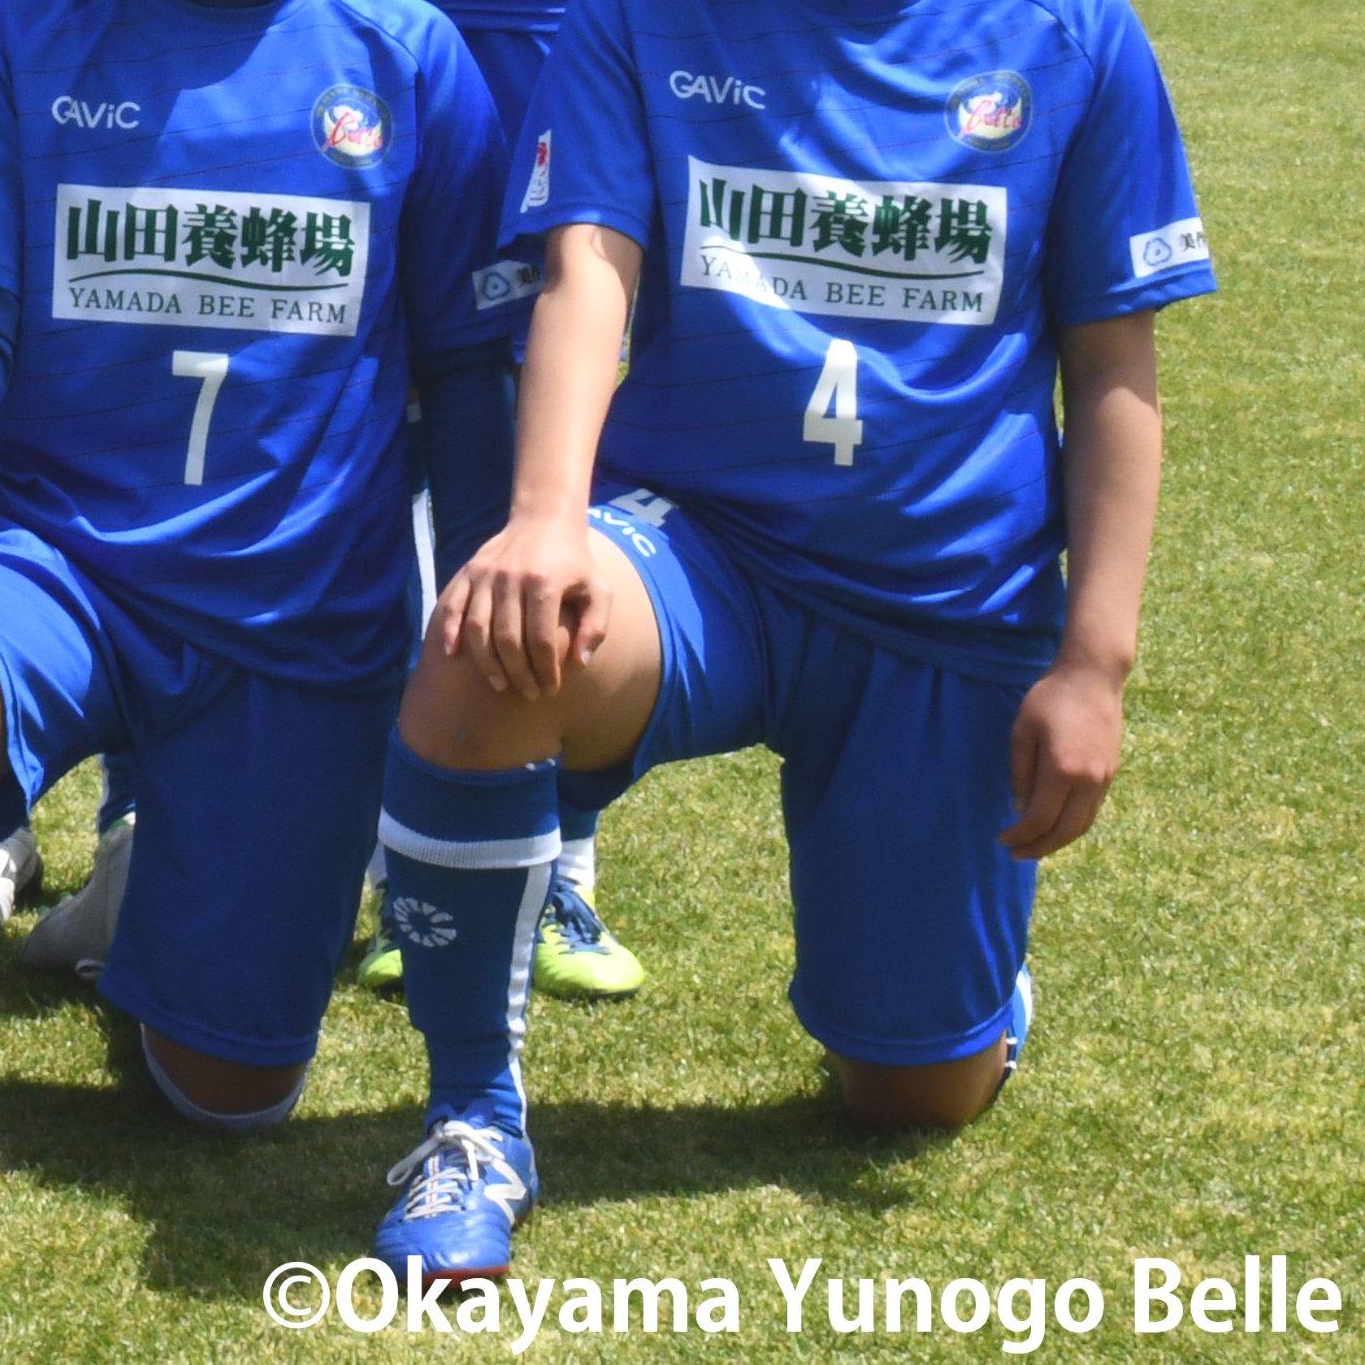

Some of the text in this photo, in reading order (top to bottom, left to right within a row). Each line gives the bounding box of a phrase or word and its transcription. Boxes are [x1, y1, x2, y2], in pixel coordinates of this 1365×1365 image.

[66, 198, 356, 277] 山田養蜂場
[698, 177, 993, 265] 山田養蜂場
[68, 288, 347, 325] YAMADA BEE FARM
[700, 254, 984, 313] YAMADA BEE FARM
[172, 349, 230, 486] 7
[803, 338, 863, 467] 4
